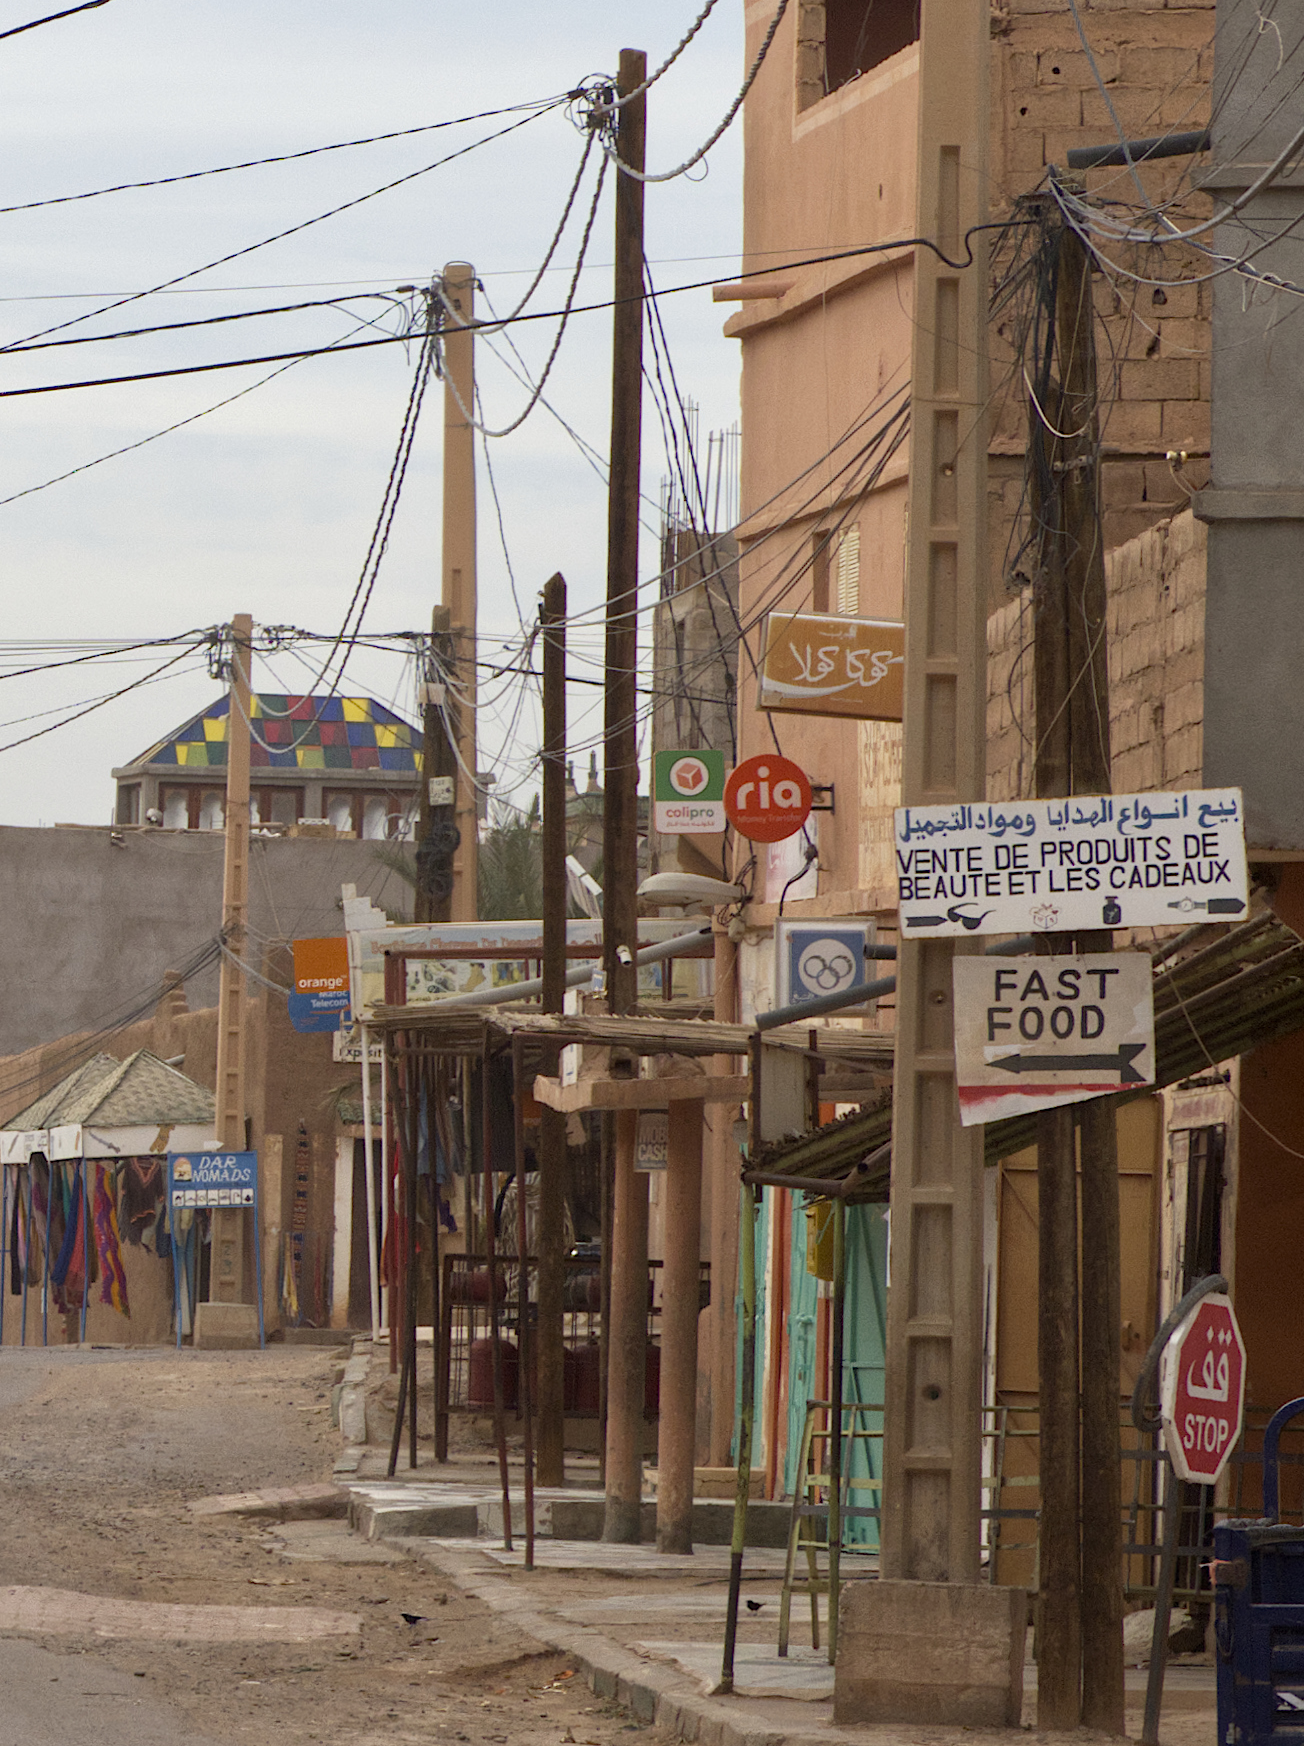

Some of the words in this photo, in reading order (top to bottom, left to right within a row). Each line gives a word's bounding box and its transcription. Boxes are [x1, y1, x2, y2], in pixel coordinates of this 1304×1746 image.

[736, 765, 803, 810] ria
[665, 807, 715, 821] colipro
[1197, 798, 1239, 829] بيع
[896, 846, 982, 875] VENTE
[994, 843, 1029, 869] DE
[1041, 836, 1171, 867] PRODUITS
[1183, 832, 1219, 859] DE
[898, 873, 1001, 901] BEAUTE
[1008, 870, 1041, 895] ET
[1048, 866, 1101, 893] LES
[1109, 859, 1232, 890] CADEAUX
[298, 977, 343, 990] orange
[994, 968, 1120, 1002] FAST
[310, 999, 349, 1008] Telecom
[987, 1005, 1105, 1041] FOOD
[192, 1168, 252, 1182] NOMADS
[197, 1155, 238, 1169] DAR
[1186, 1325, 1233, 1402] قف
[1183, 1413, 1229, 1454] STOP
